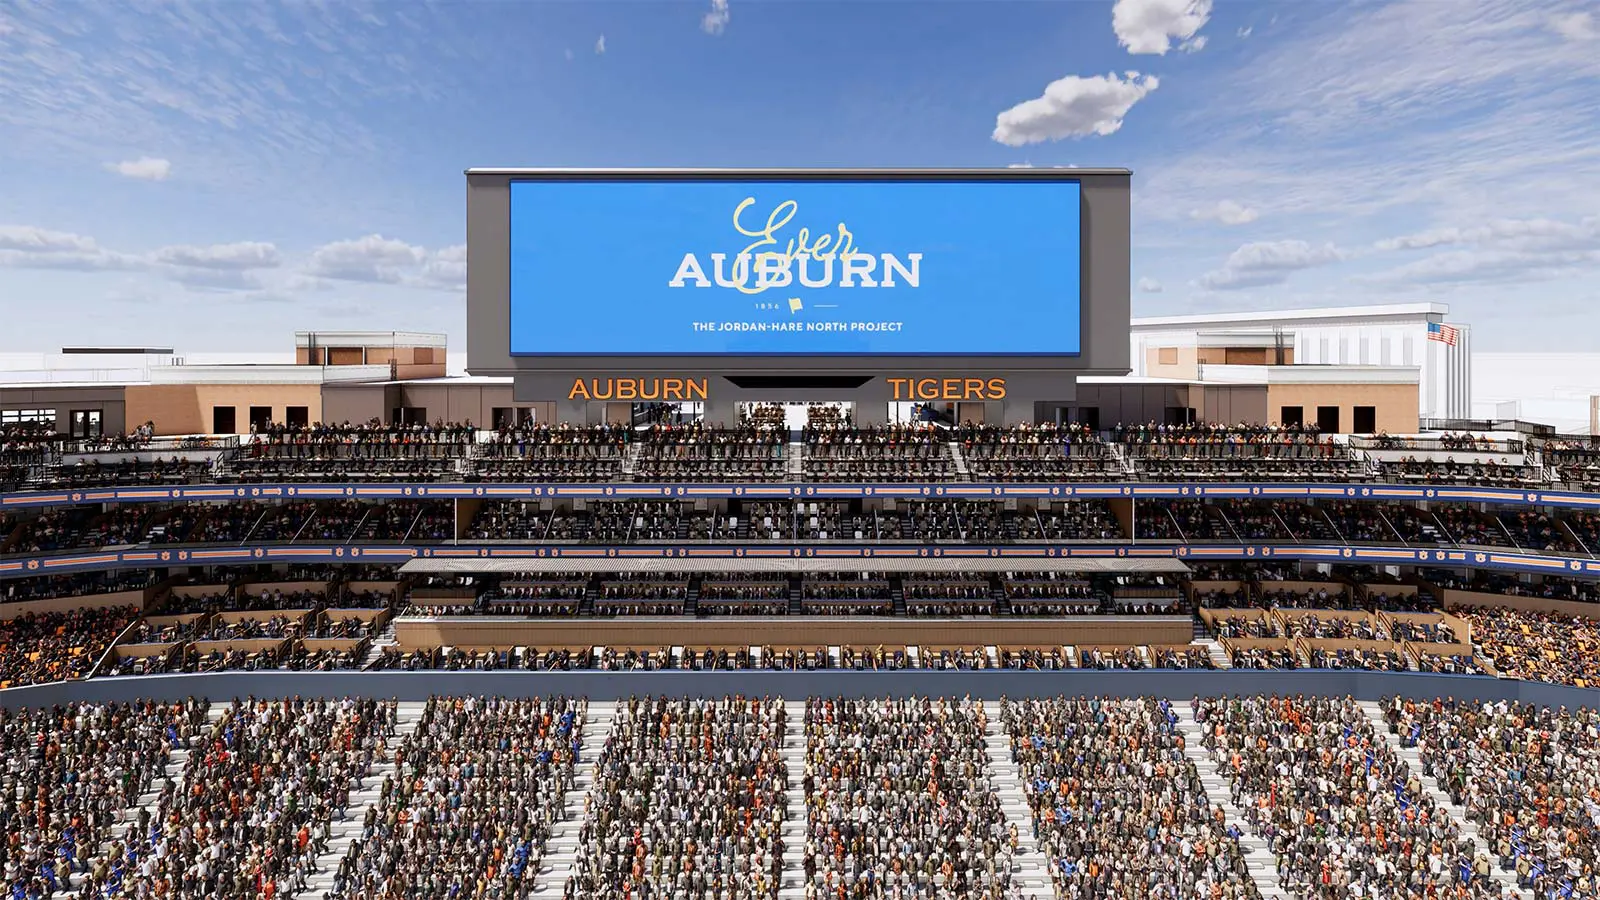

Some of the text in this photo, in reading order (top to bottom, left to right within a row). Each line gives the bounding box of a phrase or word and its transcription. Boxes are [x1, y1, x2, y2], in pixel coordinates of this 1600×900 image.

[732, 196, 858, 294] Ever
[668, 252, 923, 288] AUBURN
[692, 322, 903, 332] THE JORDAN-HARE NORTH PROJECT
[567, 378, 1006, 400] AUBURN TIGERS
